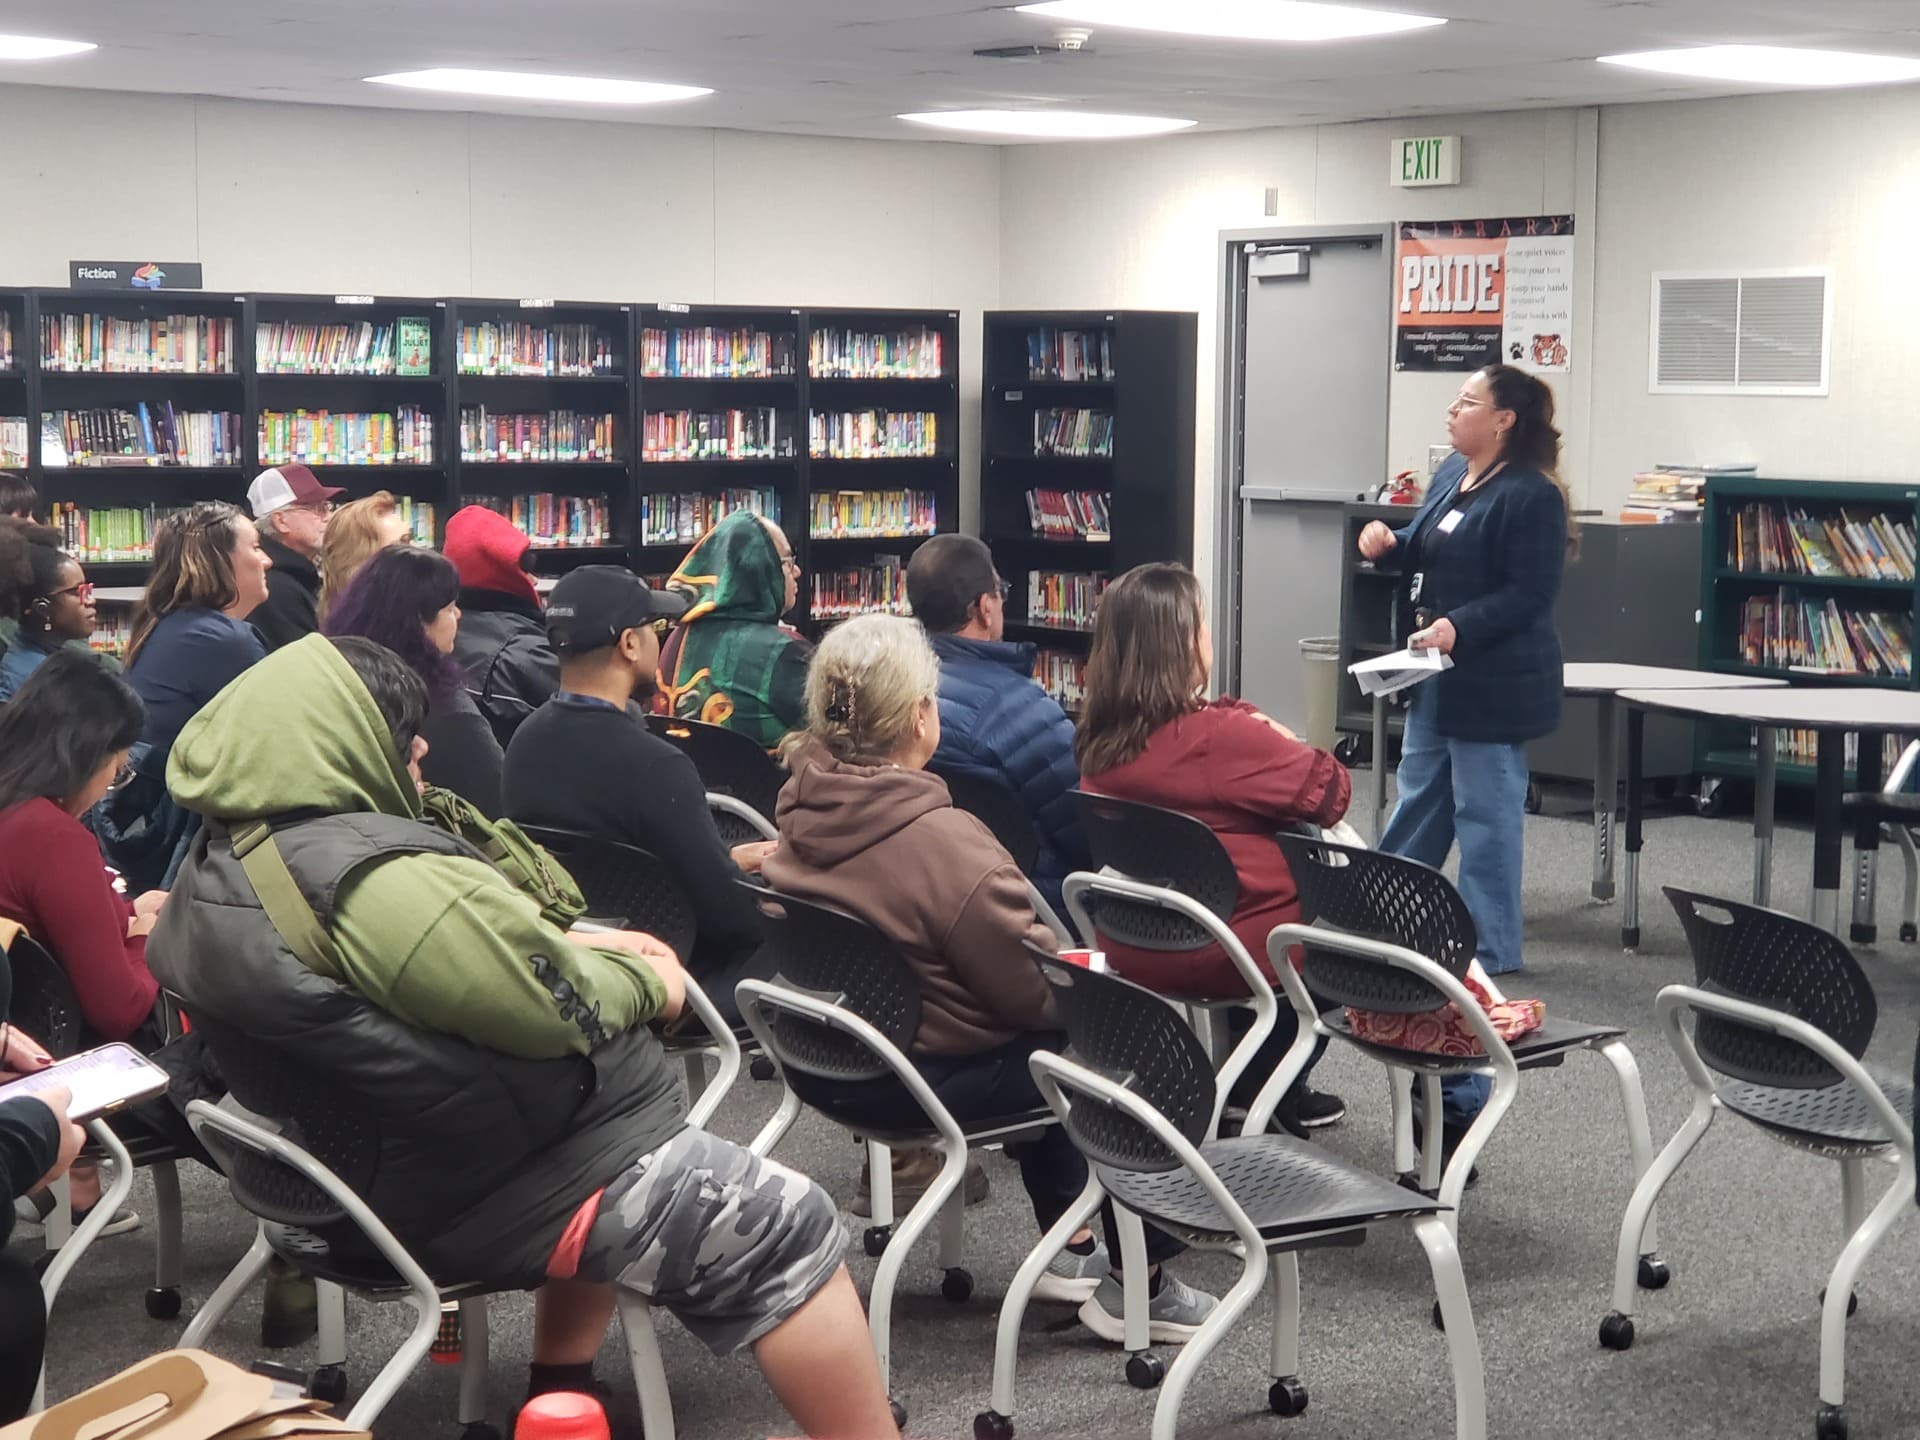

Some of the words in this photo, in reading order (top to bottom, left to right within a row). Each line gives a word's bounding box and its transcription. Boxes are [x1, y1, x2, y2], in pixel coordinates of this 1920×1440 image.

[1403, 140, 1442, 180] EXIT
[78, 267, 117, 279] Fiction
[1400, 254, 1500, 313] PRIDE
[403, 339, 428, 347] JULIET
